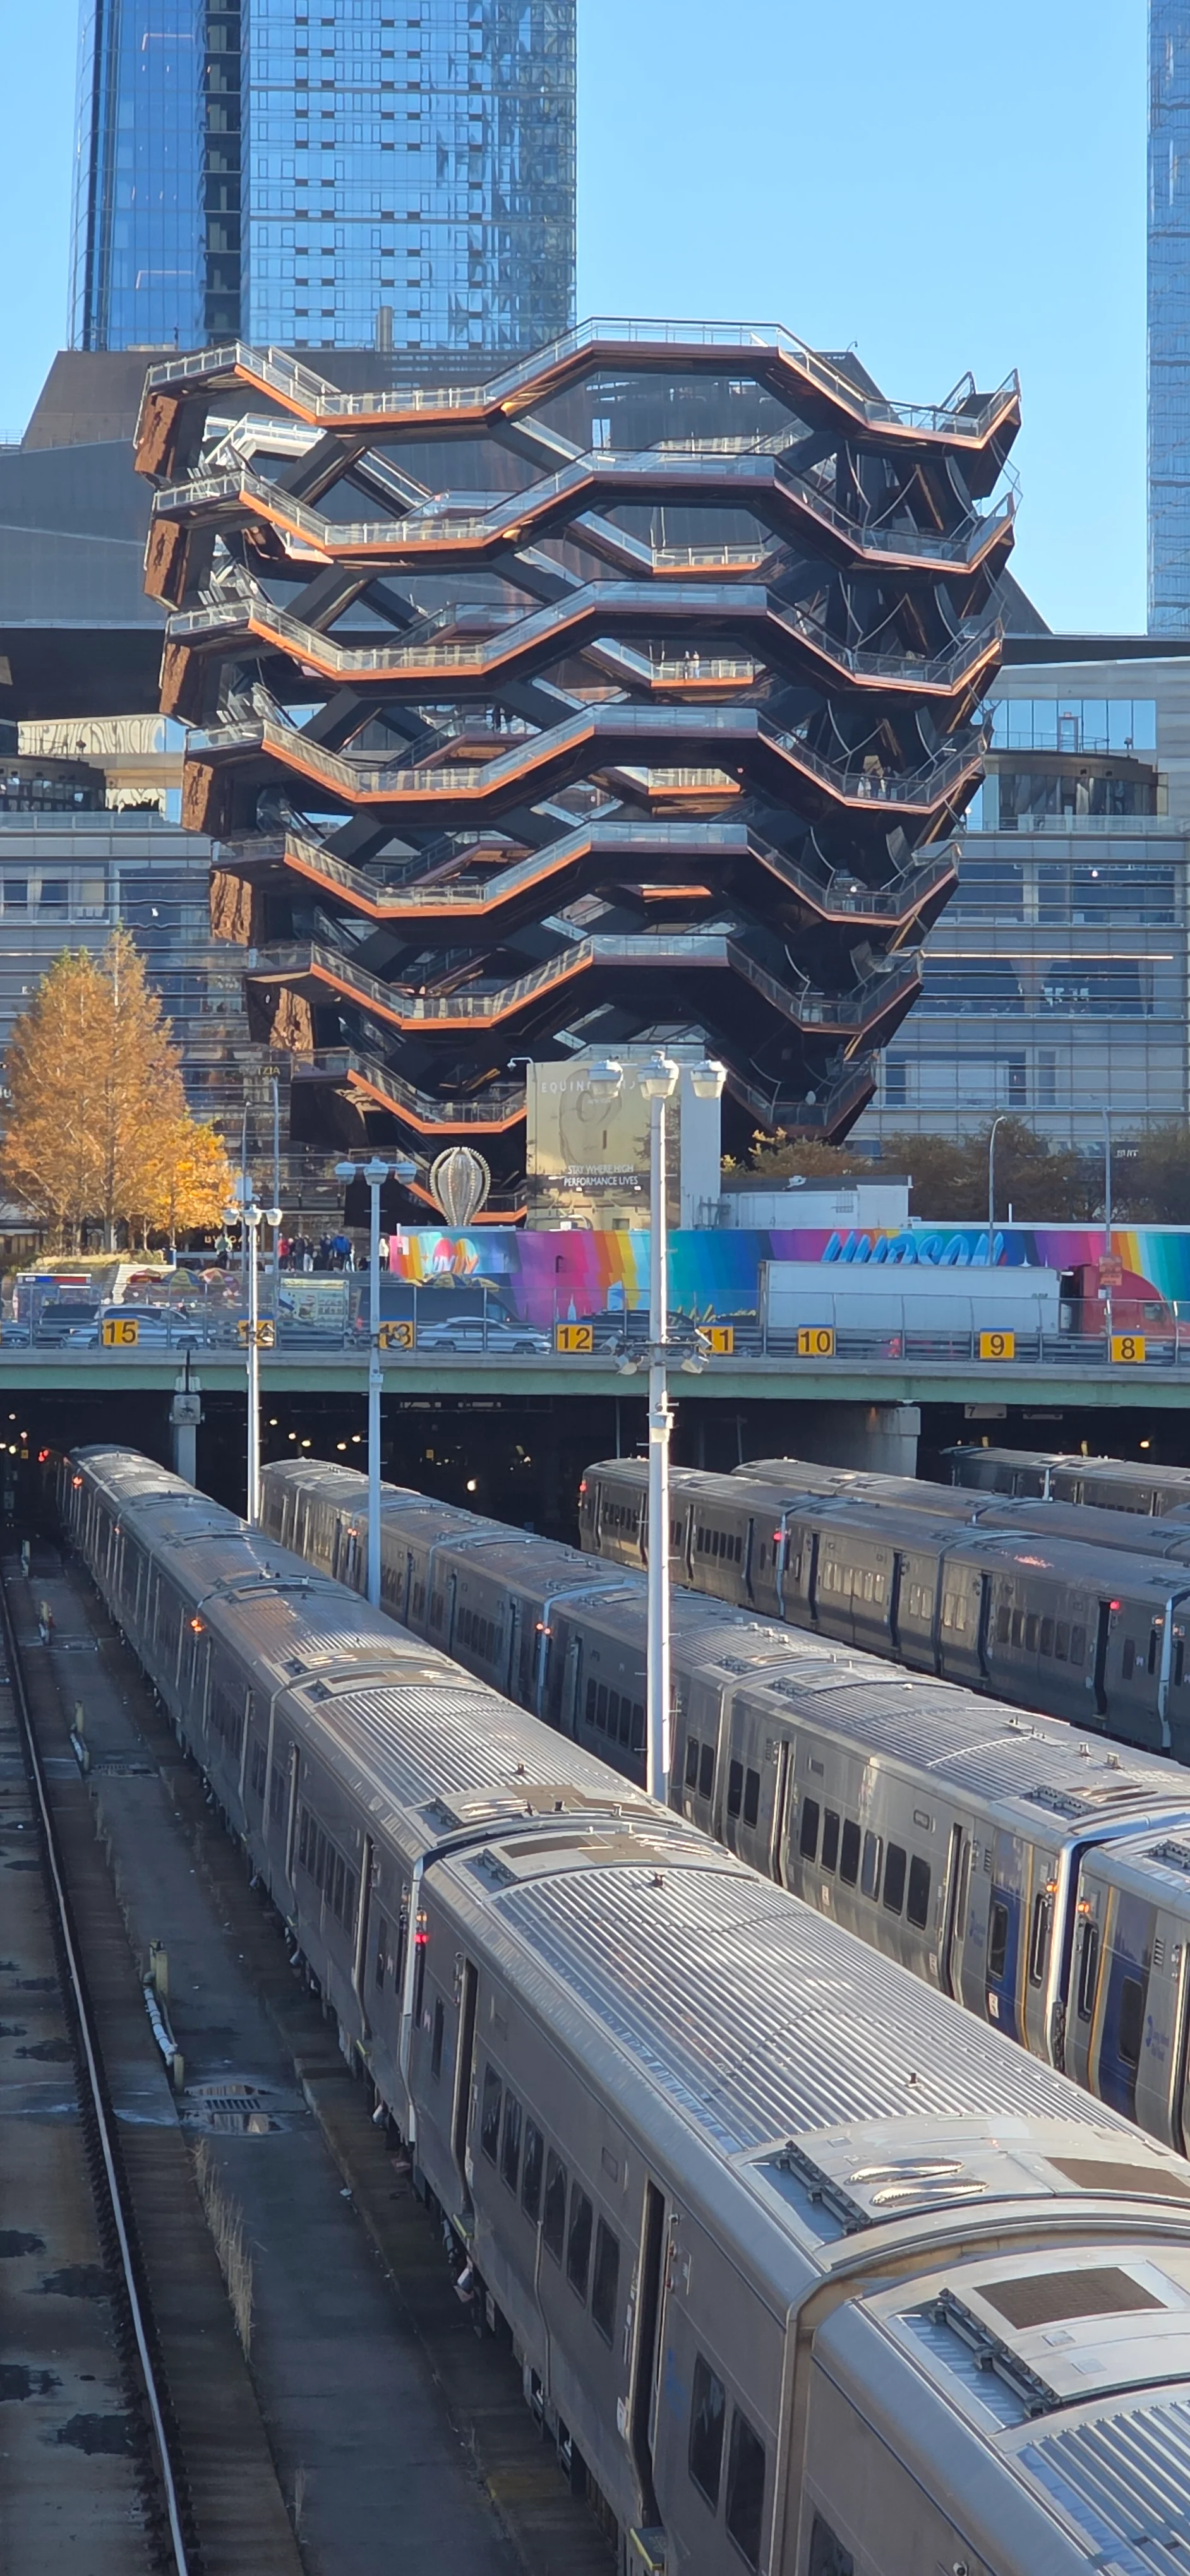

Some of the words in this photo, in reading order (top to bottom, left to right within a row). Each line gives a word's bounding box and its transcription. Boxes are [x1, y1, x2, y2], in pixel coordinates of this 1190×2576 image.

[541, 1079, 592, 1092] EQUIN
[563, 1176, 618, 1186] PERFORMANCE
[619, 1175, 638, 1185] LIVES
[568, 1164, 584, 1174] STAY
[586, 1164, 612, 1175] WHERE
[613, 1164, 634, 1173] HIGH
[105, 1321, 136, 1344] 15
[559, 1327, 590, 1349] 12
[800, 1330, 831, 1353] 10
[990, 1334, 1005, 1356] 9
[1121, 1337, 1136, 1360] 8
[967, 1406, 976, 1417] 7
